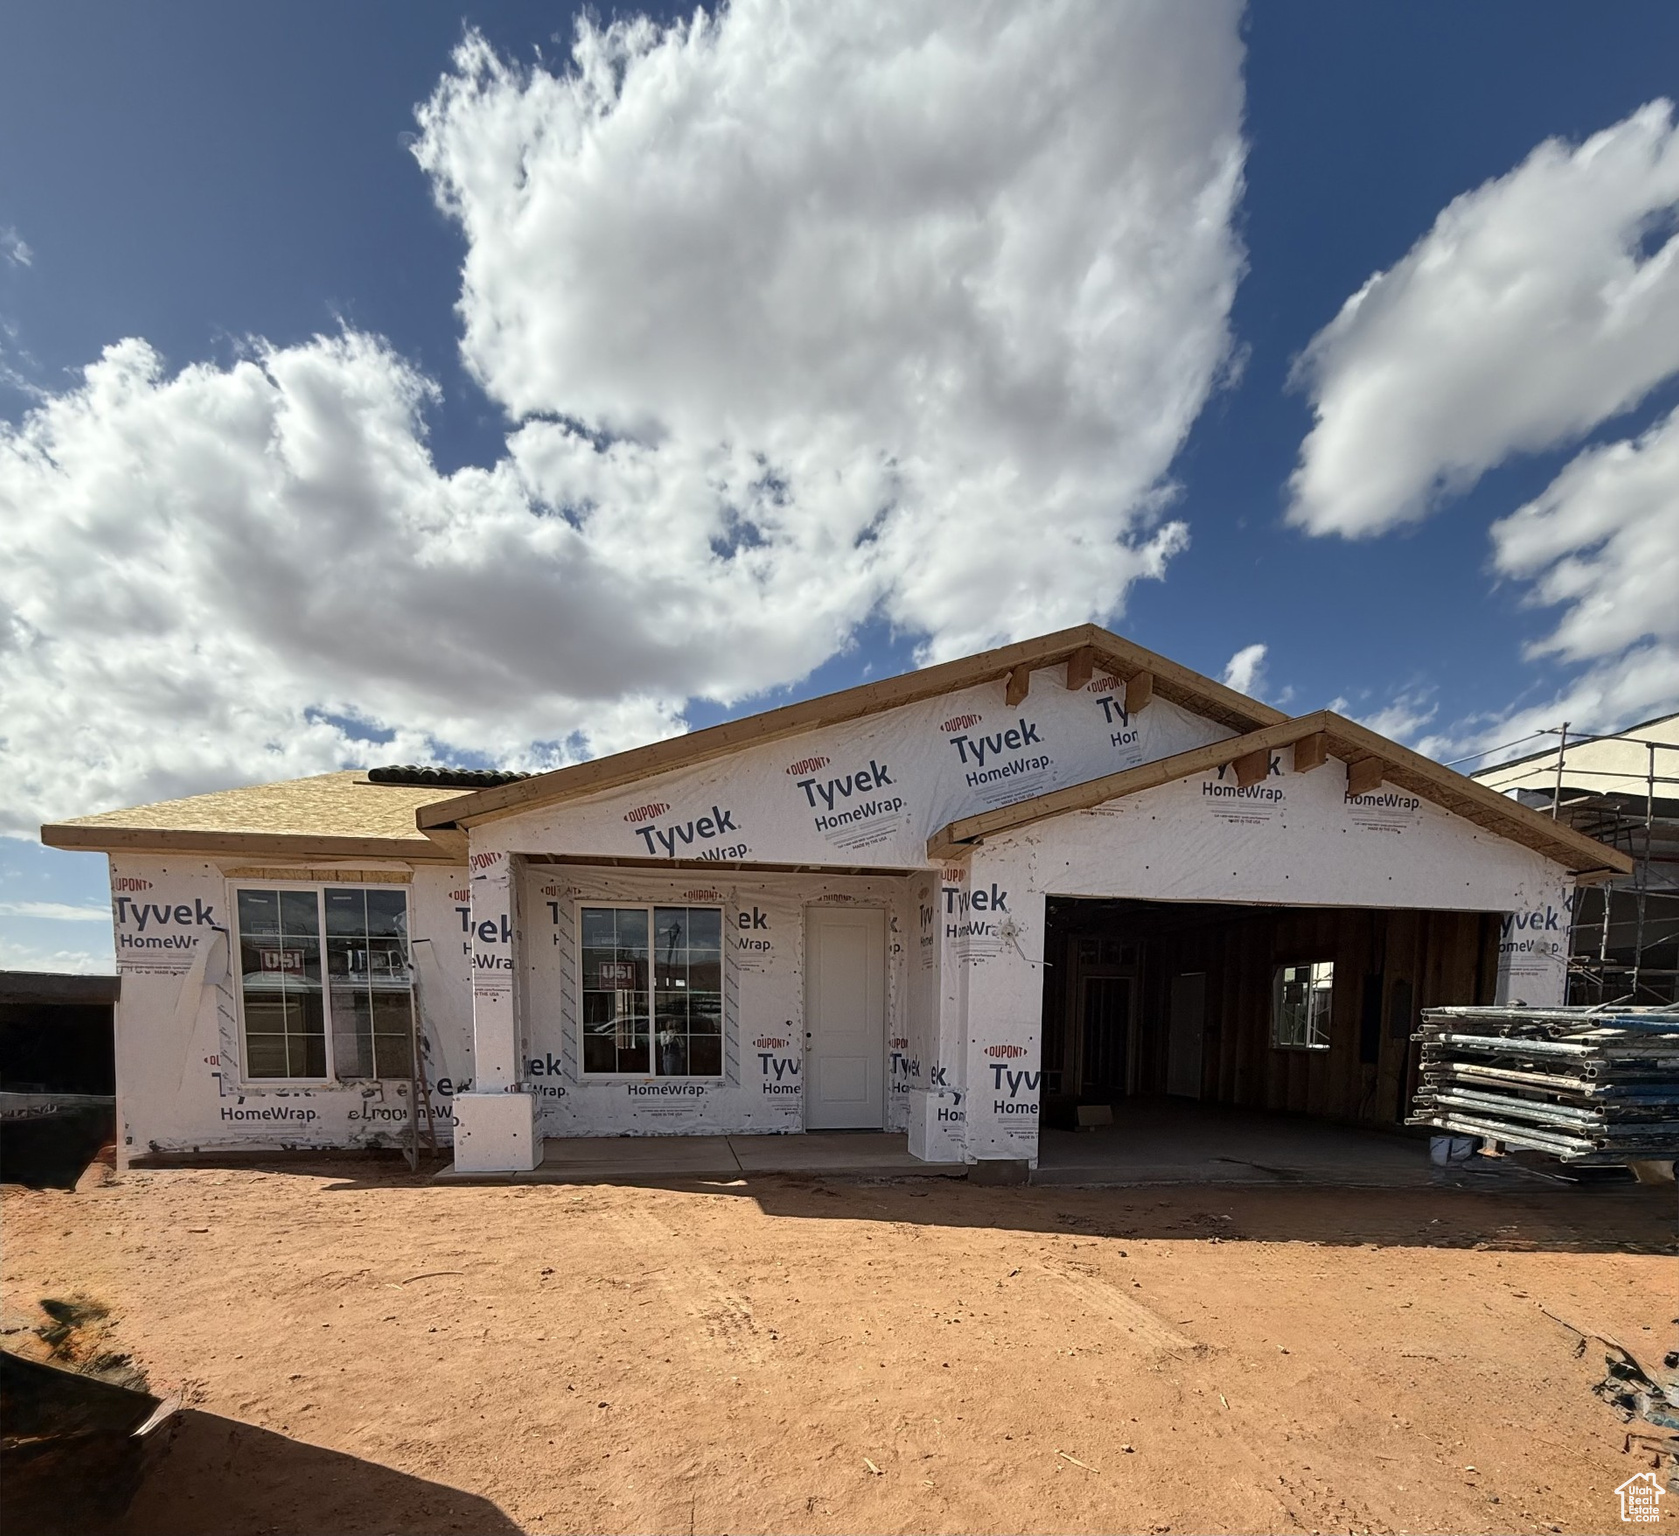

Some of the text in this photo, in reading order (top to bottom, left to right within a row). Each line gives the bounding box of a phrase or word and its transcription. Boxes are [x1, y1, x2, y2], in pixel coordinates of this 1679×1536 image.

[944, 714, 979, 732] DUPONT
[950, 718, 1040, 767] Tyvek
[790, 757, 827, 776] DUPONT
[965, 755, 1050, 787] HomeWrap
[797, 759, 894, 811] Tyvek
[1202, 781, 1283, 803] HomeWrap
[1343, 791, 1420, 811] HomeWrap
[628, 803, 666, 823] DUPONT
[814, 796, 902, 832] HomeWrap
[635, 805, 737, 858] Tyvek
[470, 852, 498, 871] PONT
[115, 897, 216, 932] Tyvek
[739, 906, 768, 930] ek
[264, 952, 300, 969] USI
[602, 965, 632, 980] USI
[757, 1038, 786, 1049] DUPONT
[989, 1045, 1023, 1058] DUPONT
[628, 1084, 704, 1097] HomeWrap
[762, 1083, 801, 1094] Home
[989, 1064, 1041, 1098] Tyv
[220, 1107, 316, 1122] HomeWrap
[994, 1100, 1038, 1114] Home
